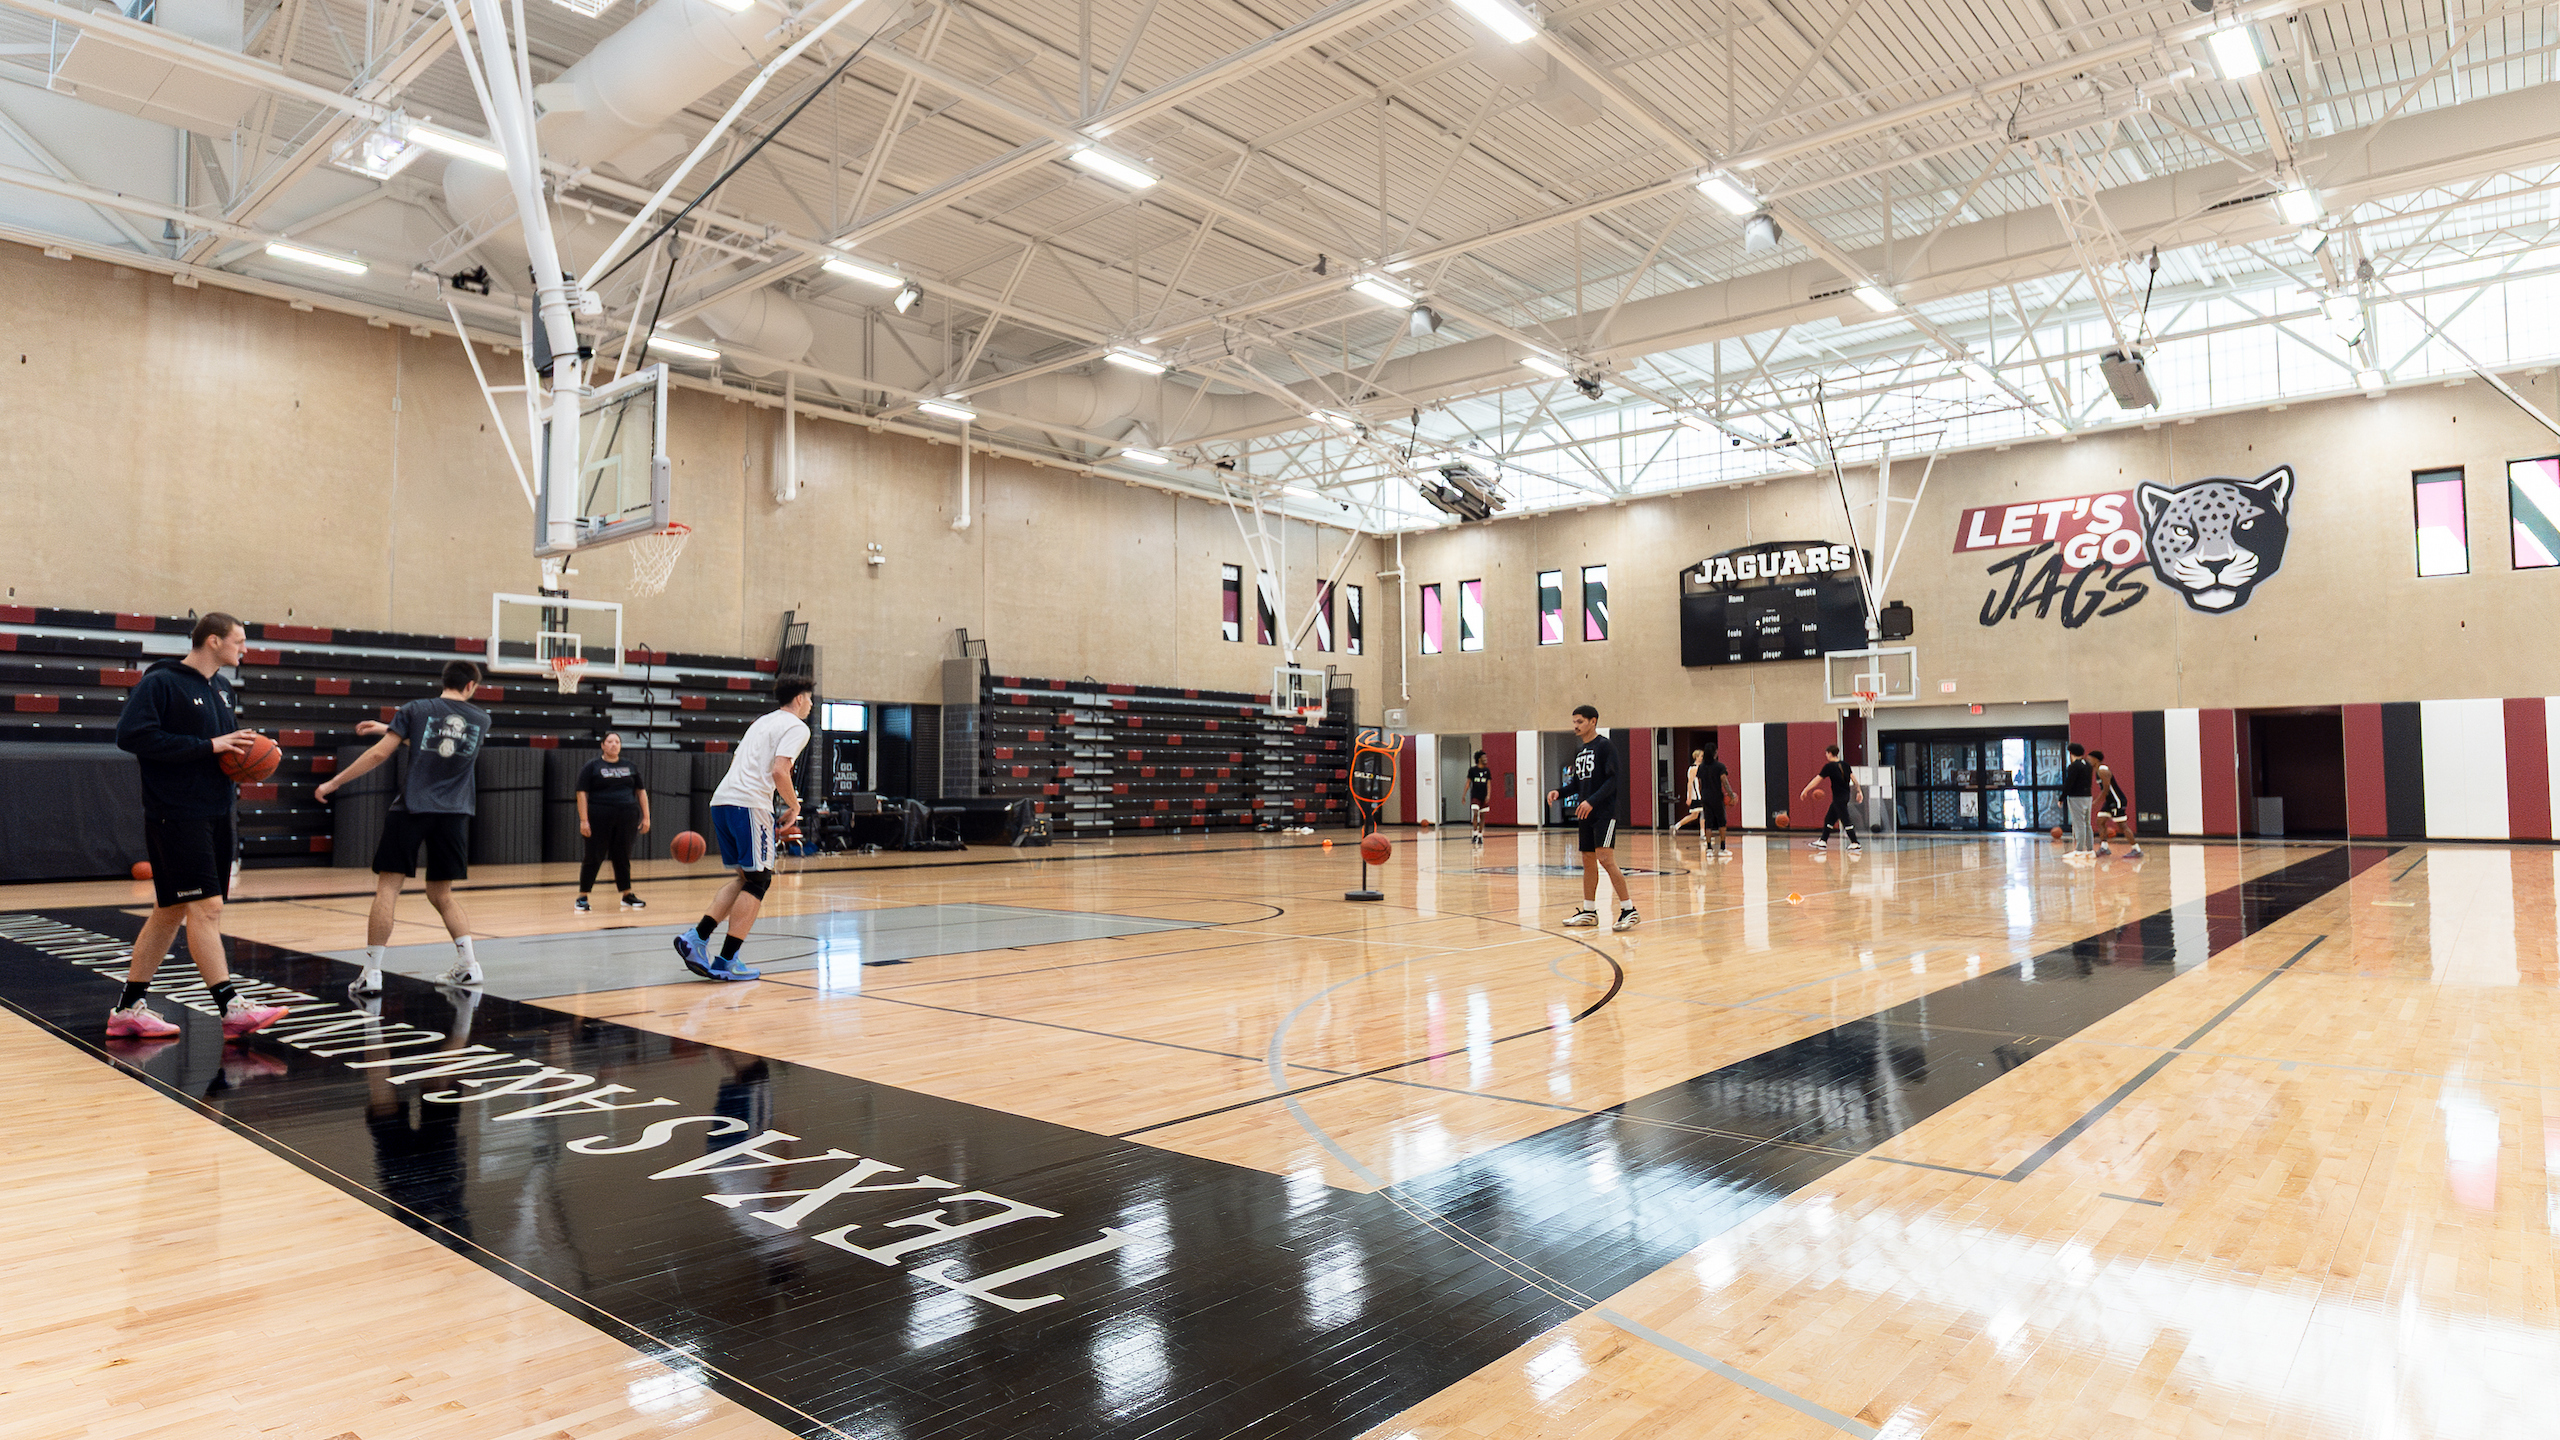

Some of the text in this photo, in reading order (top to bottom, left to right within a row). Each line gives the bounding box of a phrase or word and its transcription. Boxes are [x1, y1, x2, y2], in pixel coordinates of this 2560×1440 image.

[1965, 494, 2127, 549] LET'S
[2063, 529, 2142, 569] GO
[1694, 544, 1851, 584] JAGUARS
[1979, 540, 2151, 629] JAGS
[835, 771, 858, 780] JAGS
[344, 1043, 680, 1121] A&M
[566, 1115, 1142, 1313] TEXAS
